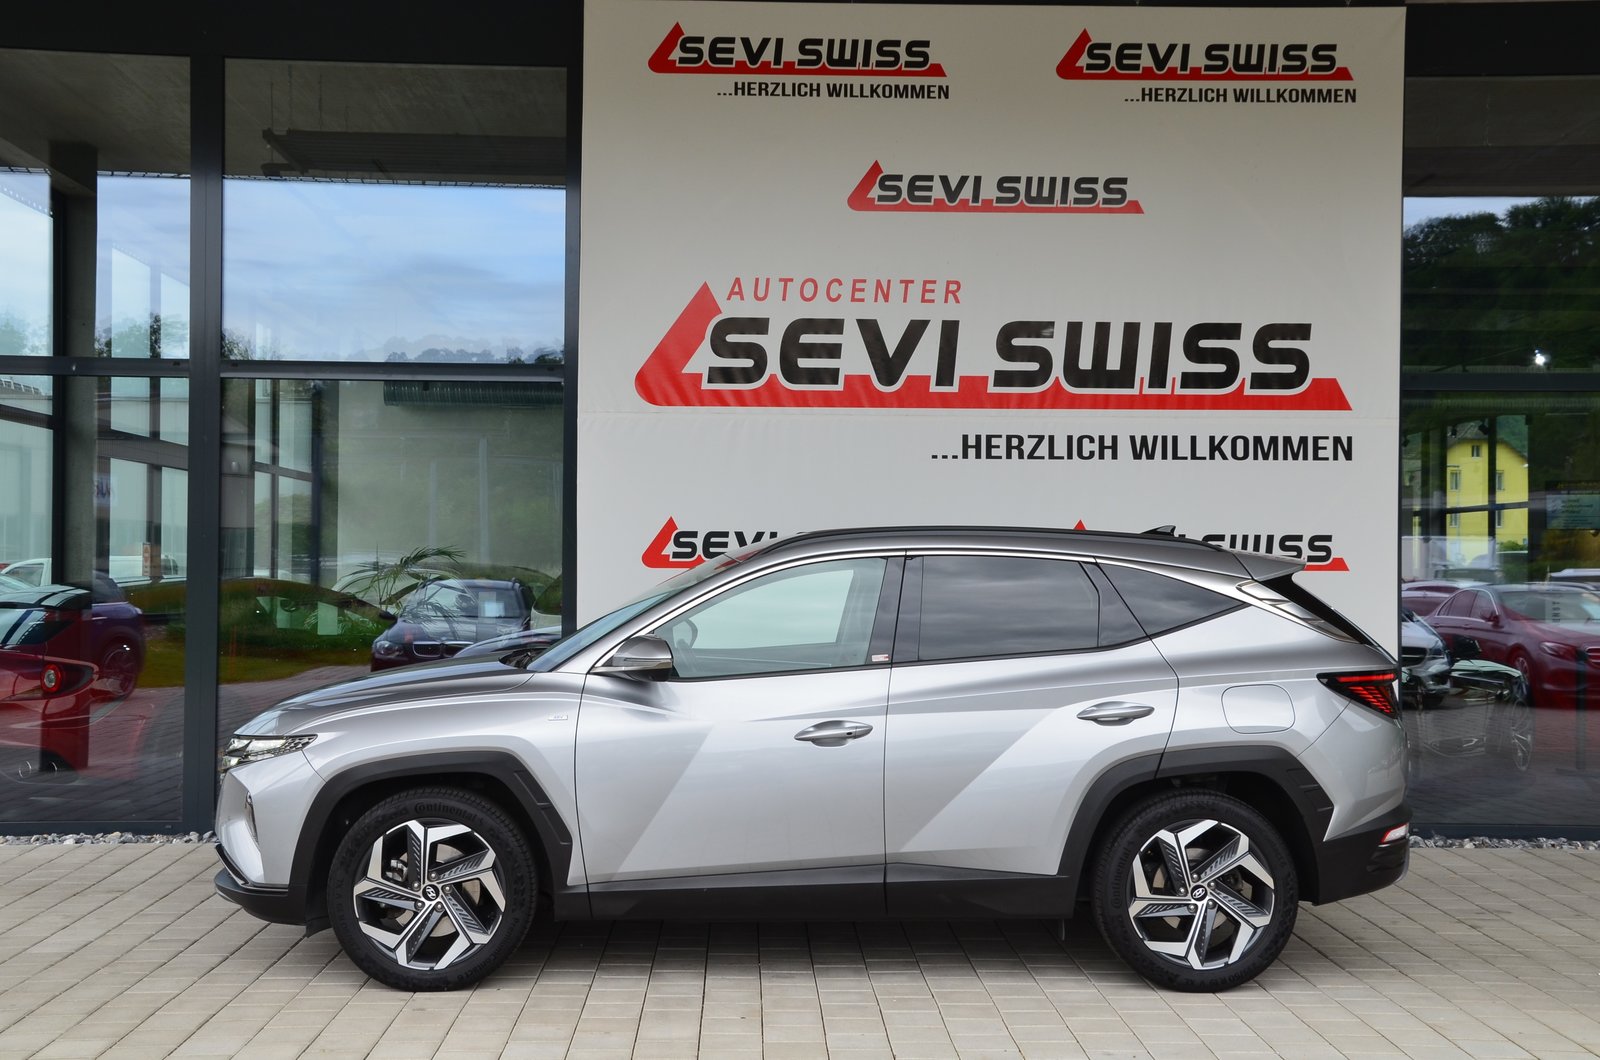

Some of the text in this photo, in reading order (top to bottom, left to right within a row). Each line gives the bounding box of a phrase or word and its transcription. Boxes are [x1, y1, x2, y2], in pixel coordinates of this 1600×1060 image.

[677, 35, 931, 69] SEVI SWISS
[1085, 42, 1338, 74] SEVI SWISS
[716, 81, 950, 100] ...HERZLICH WILLKOMMEN
[1124, 87, 1357, 104] ...HERZLICH WILLKOMMEN
[877, 174, 1128, 206] SEVI SWISS
[726, 276, 962, 304] AUTOCENTER
[707, 317, 1312, 391] SEVI SWISS
[931, 434, 1353, 461] ...HERZLICH WILLKOMMEN
[414, 802, 478, 822] Continental
